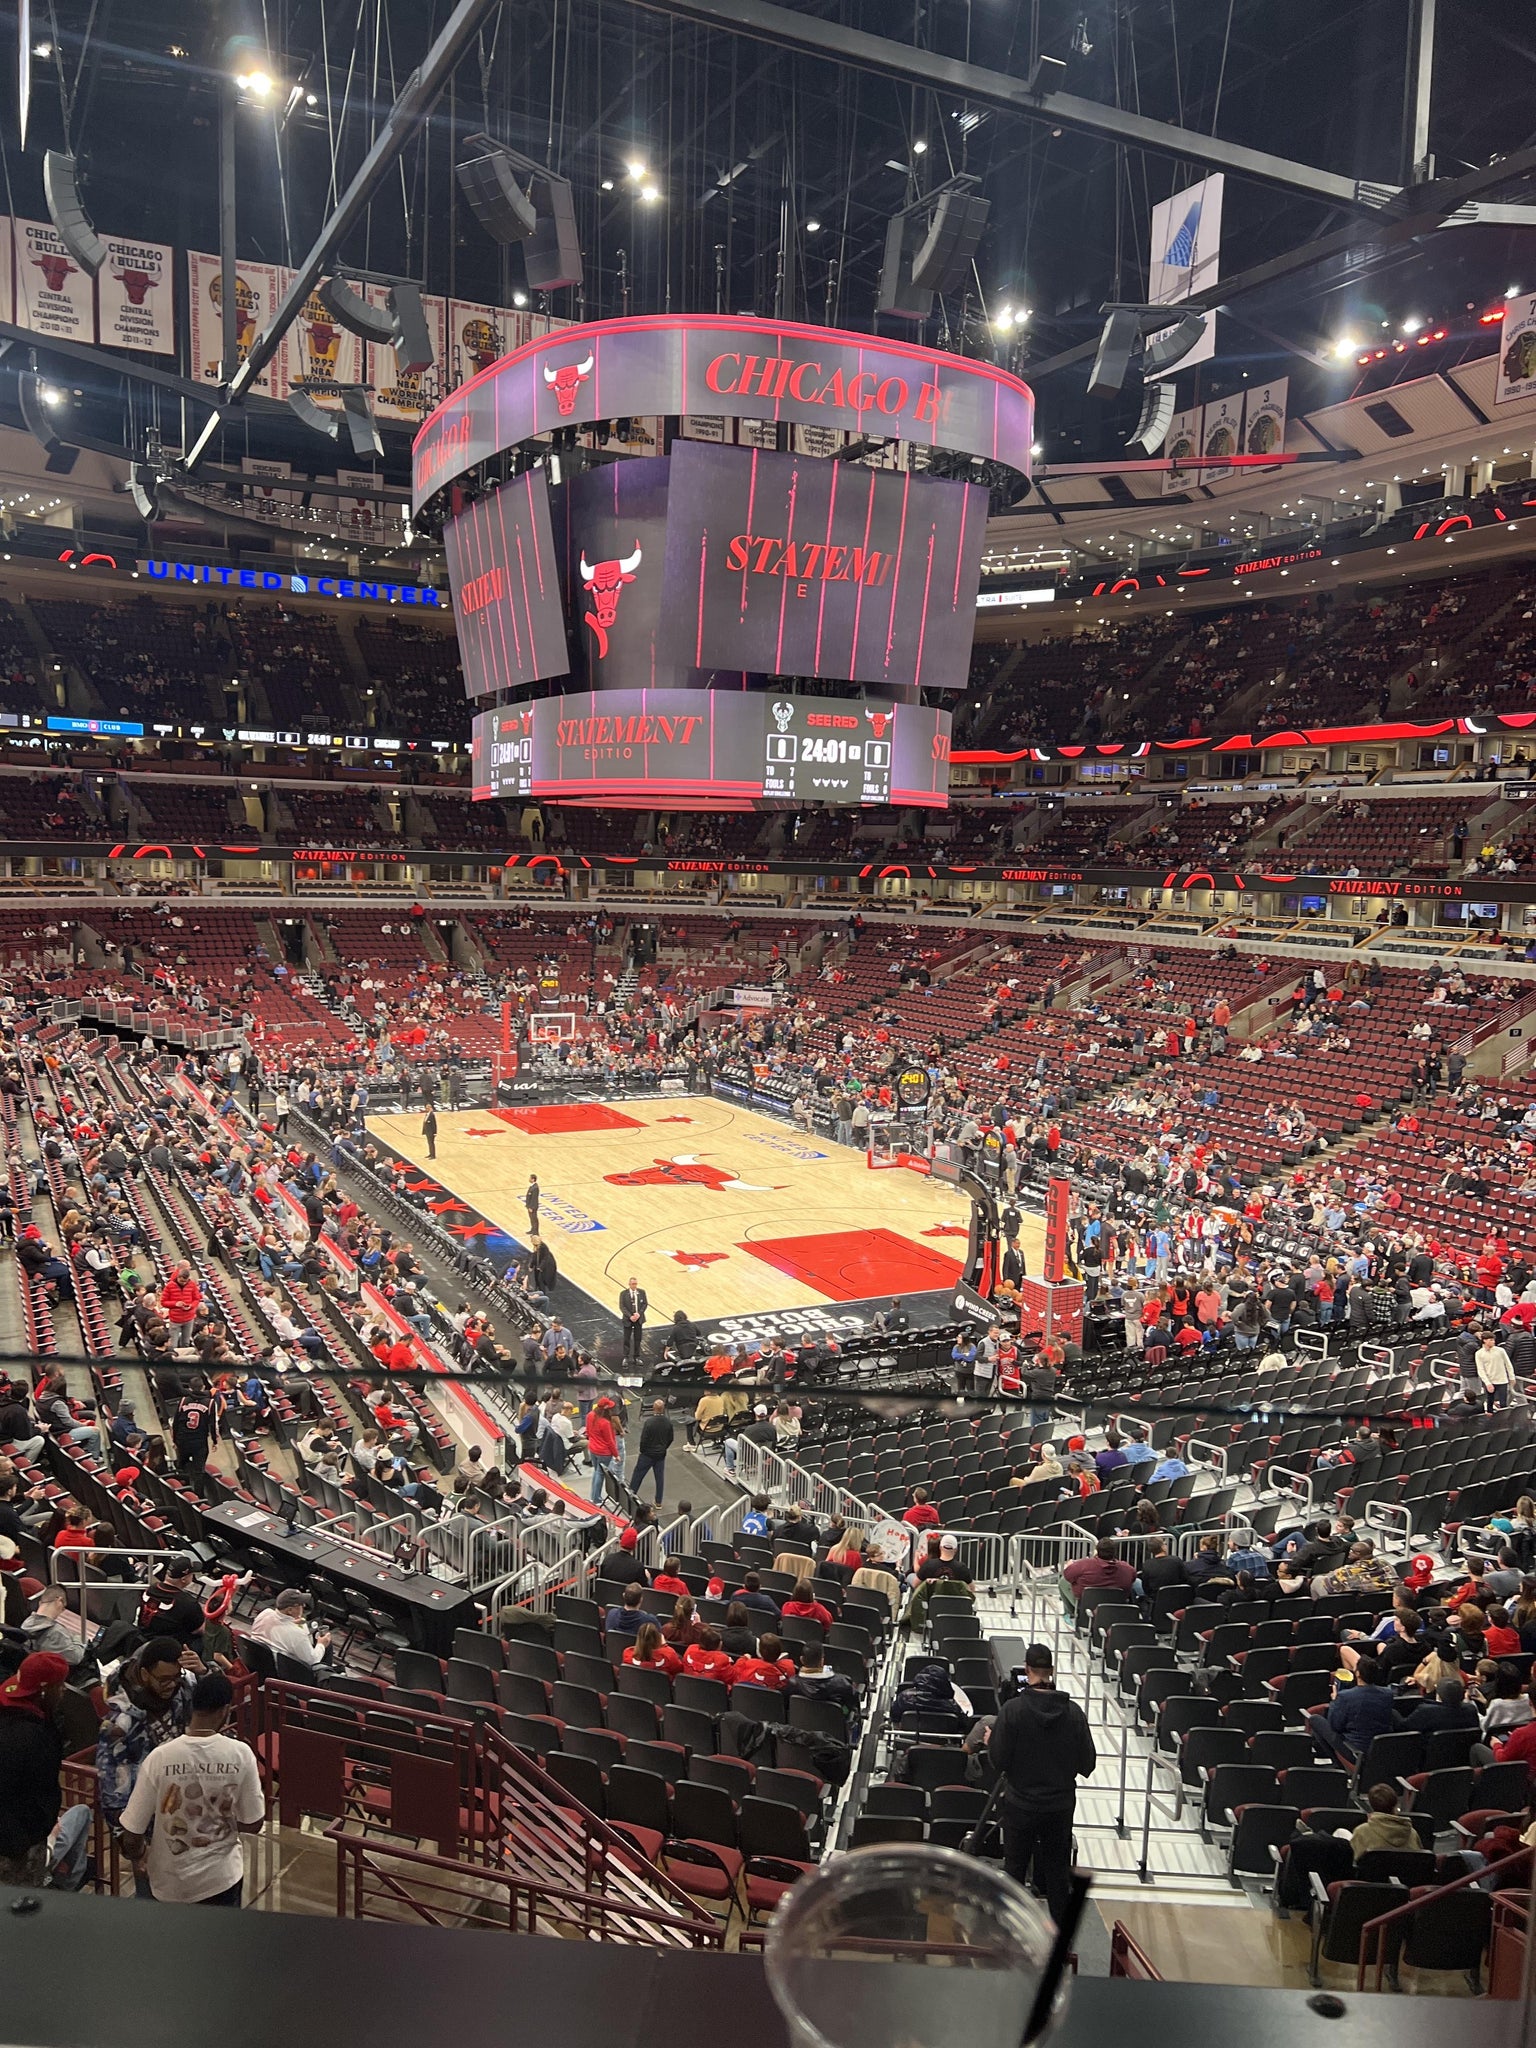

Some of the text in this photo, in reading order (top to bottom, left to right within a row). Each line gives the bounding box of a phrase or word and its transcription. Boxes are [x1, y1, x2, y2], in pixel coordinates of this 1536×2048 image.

[36, 241, 70, 256] BULL
[108, 243, 162, 261] CHICAGO
[118, 257, 156, 271] BULLS
[38, 291, 72, 304] CENTRAL
[38, 301, 74, 314] DIVISION
[120, 305, 153, 316] CENTRAL
[32, 311, 79, 325] CHAMPIONS
[120, 315, 153, 327] DIVISION
[114, 324, 159, 337] CHAMPIONS
[309, 357, 334, 367] 1992
[311, 367, 331, 377] NBA
[397, 380, 416, 390] NBA
[705, 352, 909, 415] CHICAGO
[390, 388, 423, 399] WORLD
[1264, 390, 1270, 402] 3
[1221, 404, 1226, 416] 3
[1234, 550, 1321, 574] STATEMENT EDITION
[148, 560, 438, 606] UNITED CENTER
[797, 583, 807, 598] E
[807, 713, 858, 729] SEE RED
[556, 715, 703, 747] STATEMENT
[308, 734, 330, 745] 24:01
[584, 747, 633, 759] EDITIO
[778, 739, 786, 758] 0
[802, 738, 846, 763] 24:01
[874, 745, 881, 764] 0
[790, 767, 794, 776] 7
[766, 779, 794, 790] FOULS 0
[292, 850, 406, 861] STATEMENT EDITION
[668, 861, 726, 871] STATEMENT
[1002, 870, 1048, 880] STATEMENT
[1330, 880, 1462, 895] STATEMENT EDITION
[744, 994, 769, 1002] Advocate
[760, 1133, 809, 1150] UNITED
[1124, 1192, 1132, 1200] G
[541, 1192, 588, 1219] UNITED
[1148, 1199, 1155, 1207] G
[1170, 1206, 1178, 1215] G
[1044, 1185, 1058, 1280] SEE RED
[1256, 1233, 1265, 1243] G
[1272, 1238, 1282, 1248] G
[1286, 1242, 1296, 1252] G
[1300, 1247, 1309, 1257] G
[965, 1300, 979, 1312] WIND
[978, 1308, 997, 1320] CREEK
[719, 1309, 832, 1330] BULLS
[707, 1316, 864, 1343] CHICAGO
[1003, 1365, 1014, 1374] 23
[187, 1411, 199, 1428] 3
[164, 1763, 240, 1776] TREASURES
